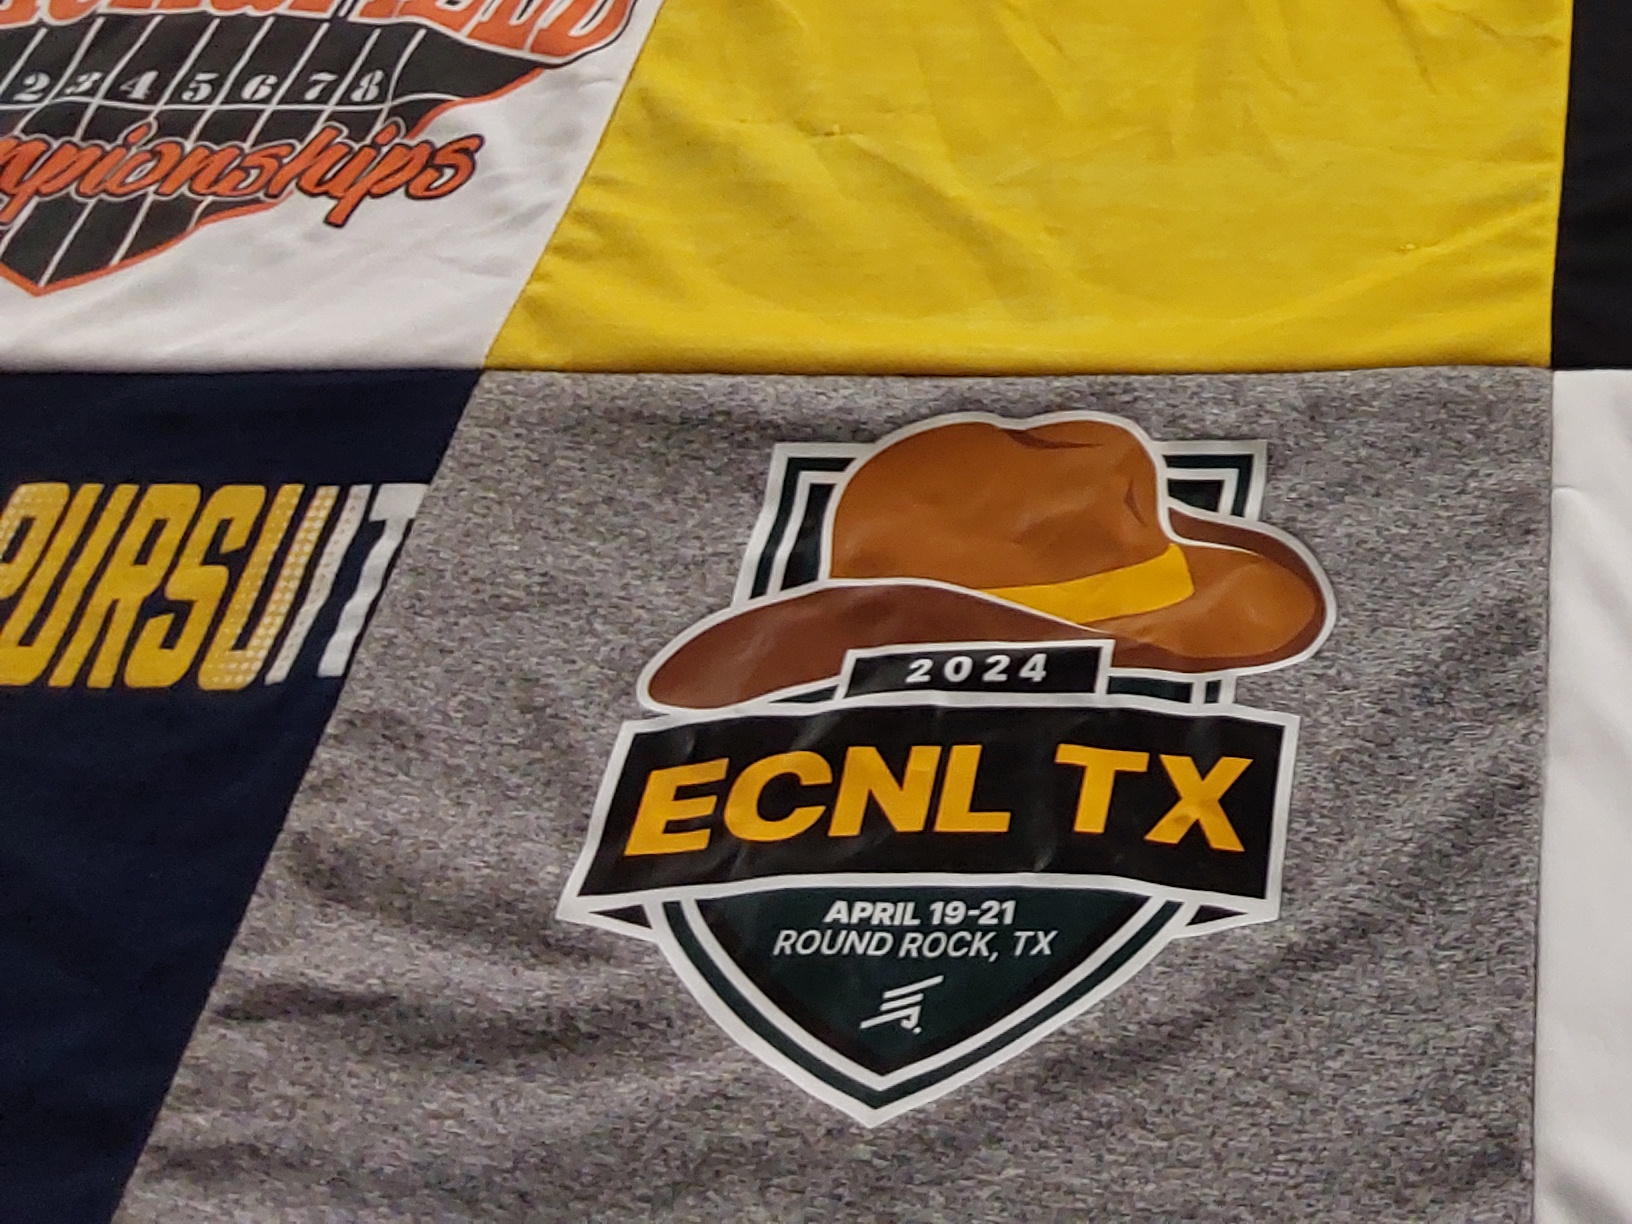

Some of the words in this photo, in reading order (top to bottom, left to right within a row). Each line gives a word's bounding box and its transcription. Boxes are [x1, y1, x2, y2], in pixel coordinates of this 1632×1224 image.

[12, 71, 51, 103] 2
[64, 71, 101, 95] 3
[119, 70, 159, 100] 4
[181, 72, 219, 103] 5
[239, 74, 278, 103] 6
[303, 72, 340, 102] 7
[350, 69, 385, 103] 8
[0, 482, 430, 691] PURSUIT
[904, 652, 1048, 684] 2024
[622, 743, 1012, 858] ECNL
[1053, 742, 1255, 854] TX
[822, 899, 922, 926] APRIL
[928, 899, 1017, 926] 19-21
[773, 928, 895, 957] ROUND
[897, 930, 999, 963] ROCK,
[1011, 929, 1059, 956] TX
